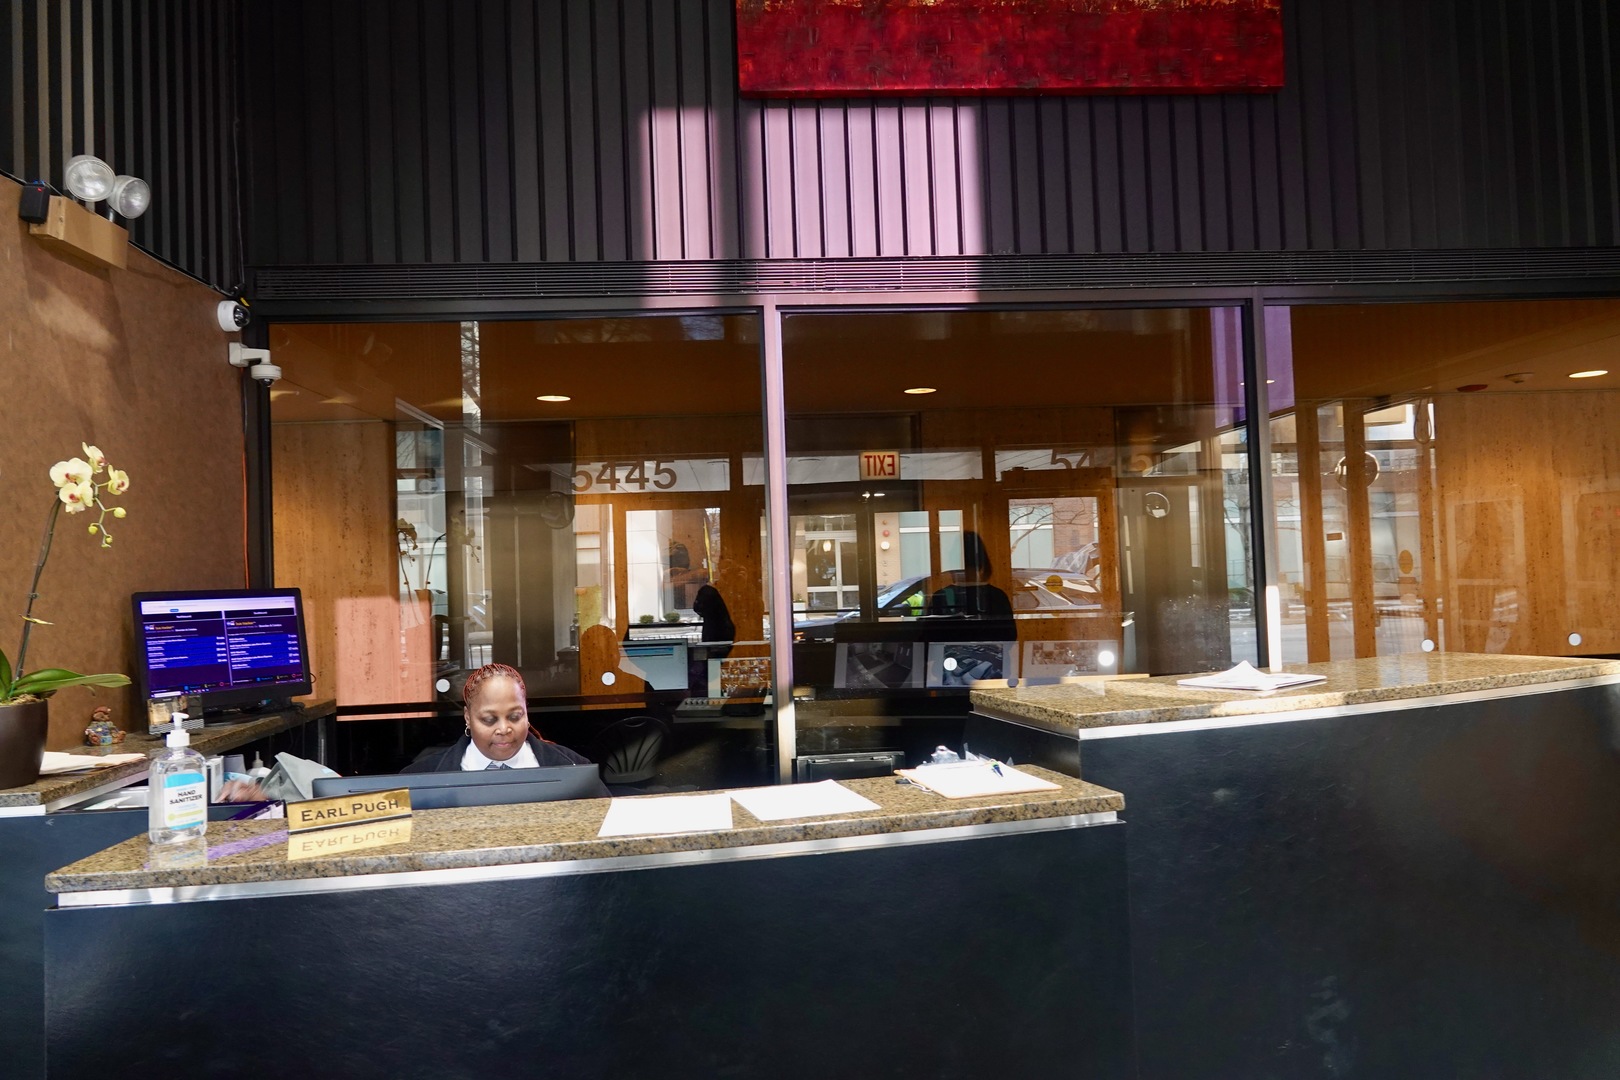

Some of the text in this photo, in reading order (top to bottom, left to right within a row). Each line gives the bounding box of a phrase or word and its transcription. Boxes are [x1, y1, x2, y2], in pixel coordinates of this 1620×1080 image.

[571, 460, 677, 492] 5445
[177, 789, 196, 797] HAND
[169, 794, 203, 805] SANITIZER
